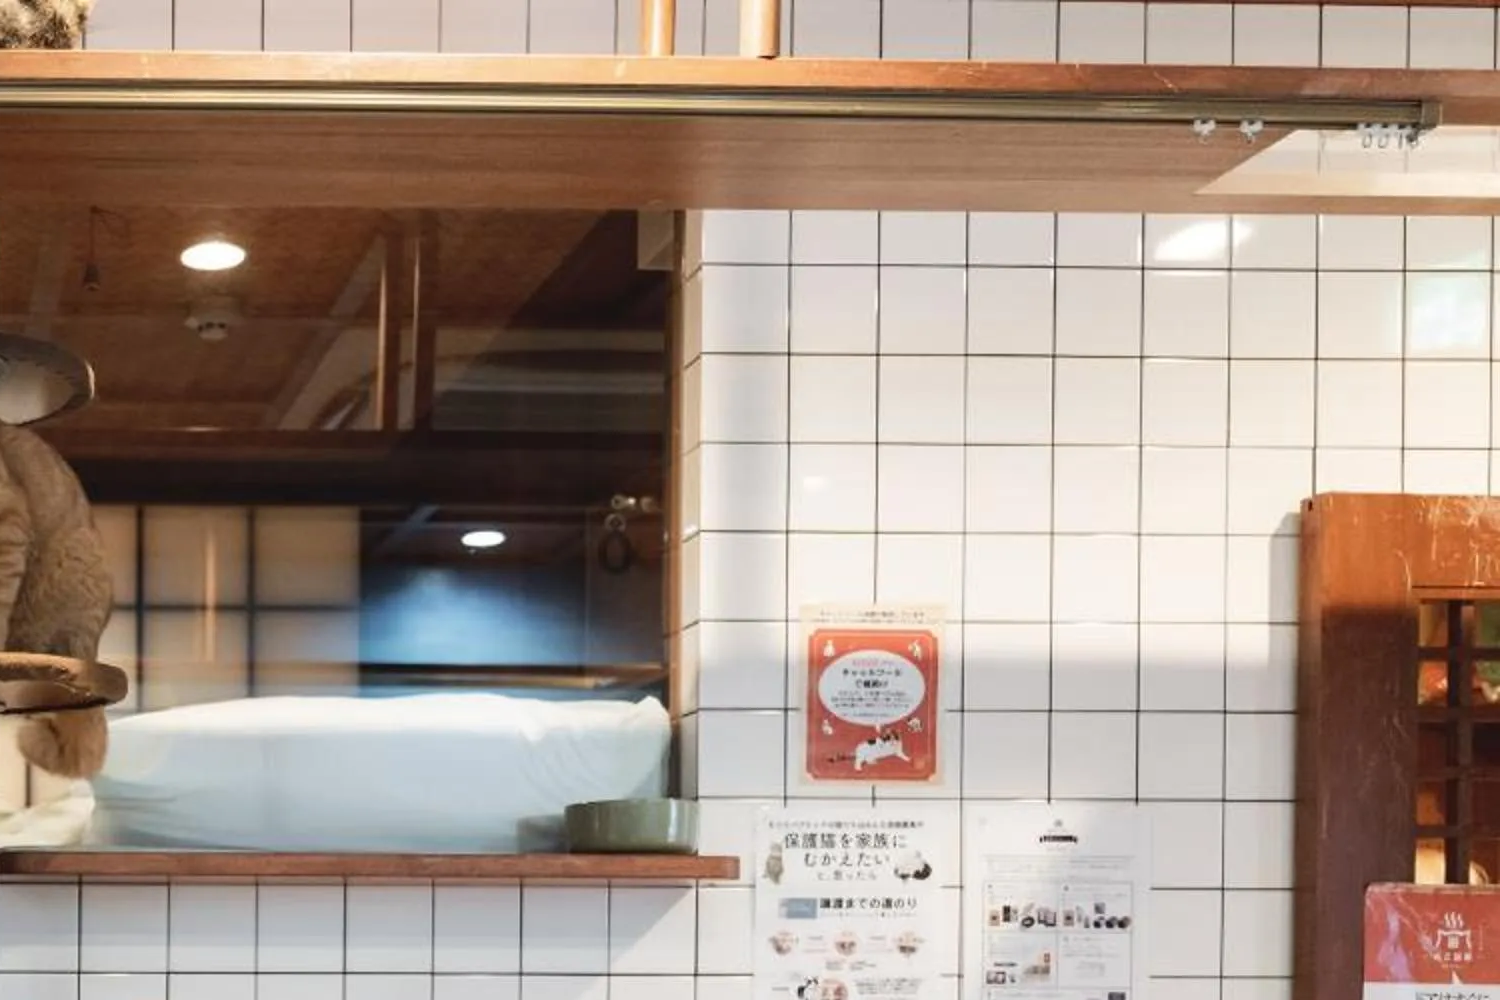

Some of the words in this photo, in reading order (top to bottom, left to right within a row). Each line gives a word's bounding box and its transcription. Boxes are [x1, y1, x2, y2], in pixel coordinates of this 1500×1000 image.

[784, 832, 908, 850] 保護猫を家族に
[803, 852, 891, 867] むかえたい
